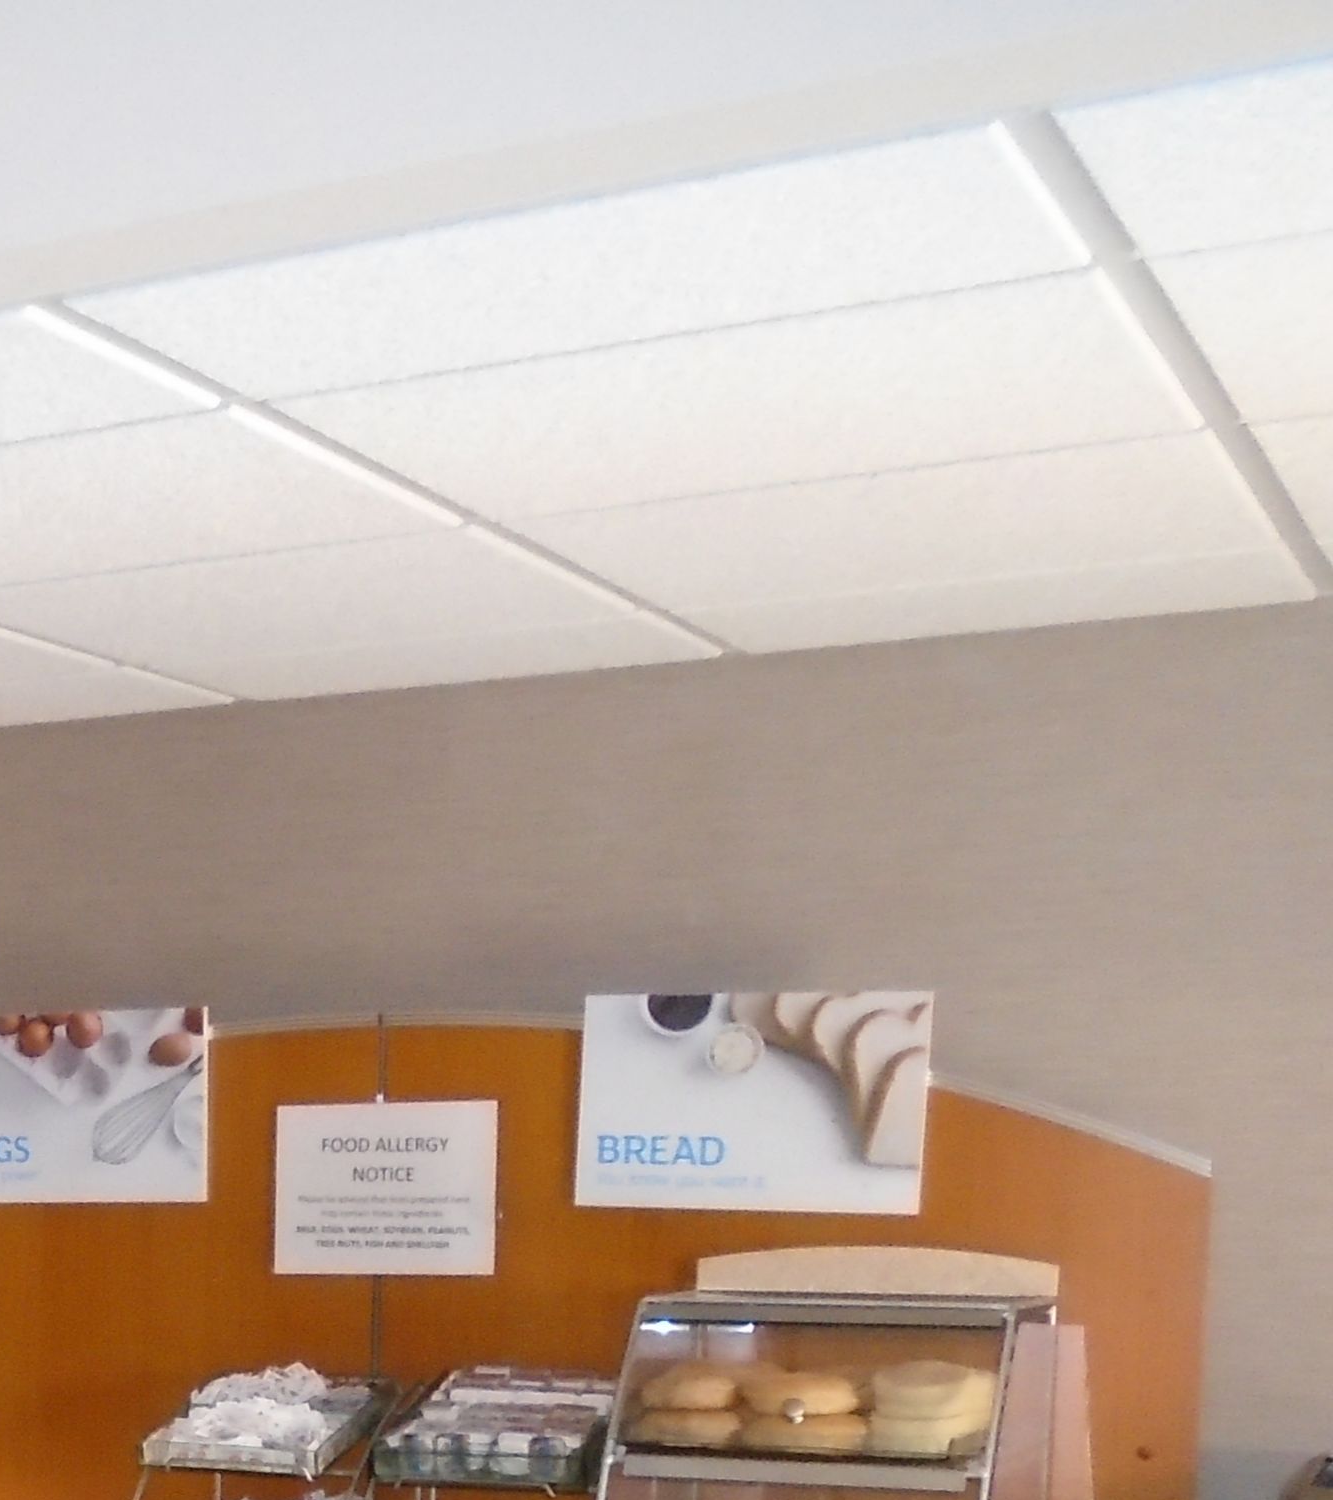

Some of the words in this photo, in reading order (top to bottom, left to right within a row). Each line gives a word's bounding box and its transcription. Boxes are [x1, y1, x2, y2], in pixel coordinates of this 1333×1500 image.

[321, 1137, 370, 1153] FOOD
[375, 1136, 449, 1153] ALLERGY
[596, 1134, 726, 1166] BREAD
[352, 1166, 415, 1183] NOTICE
